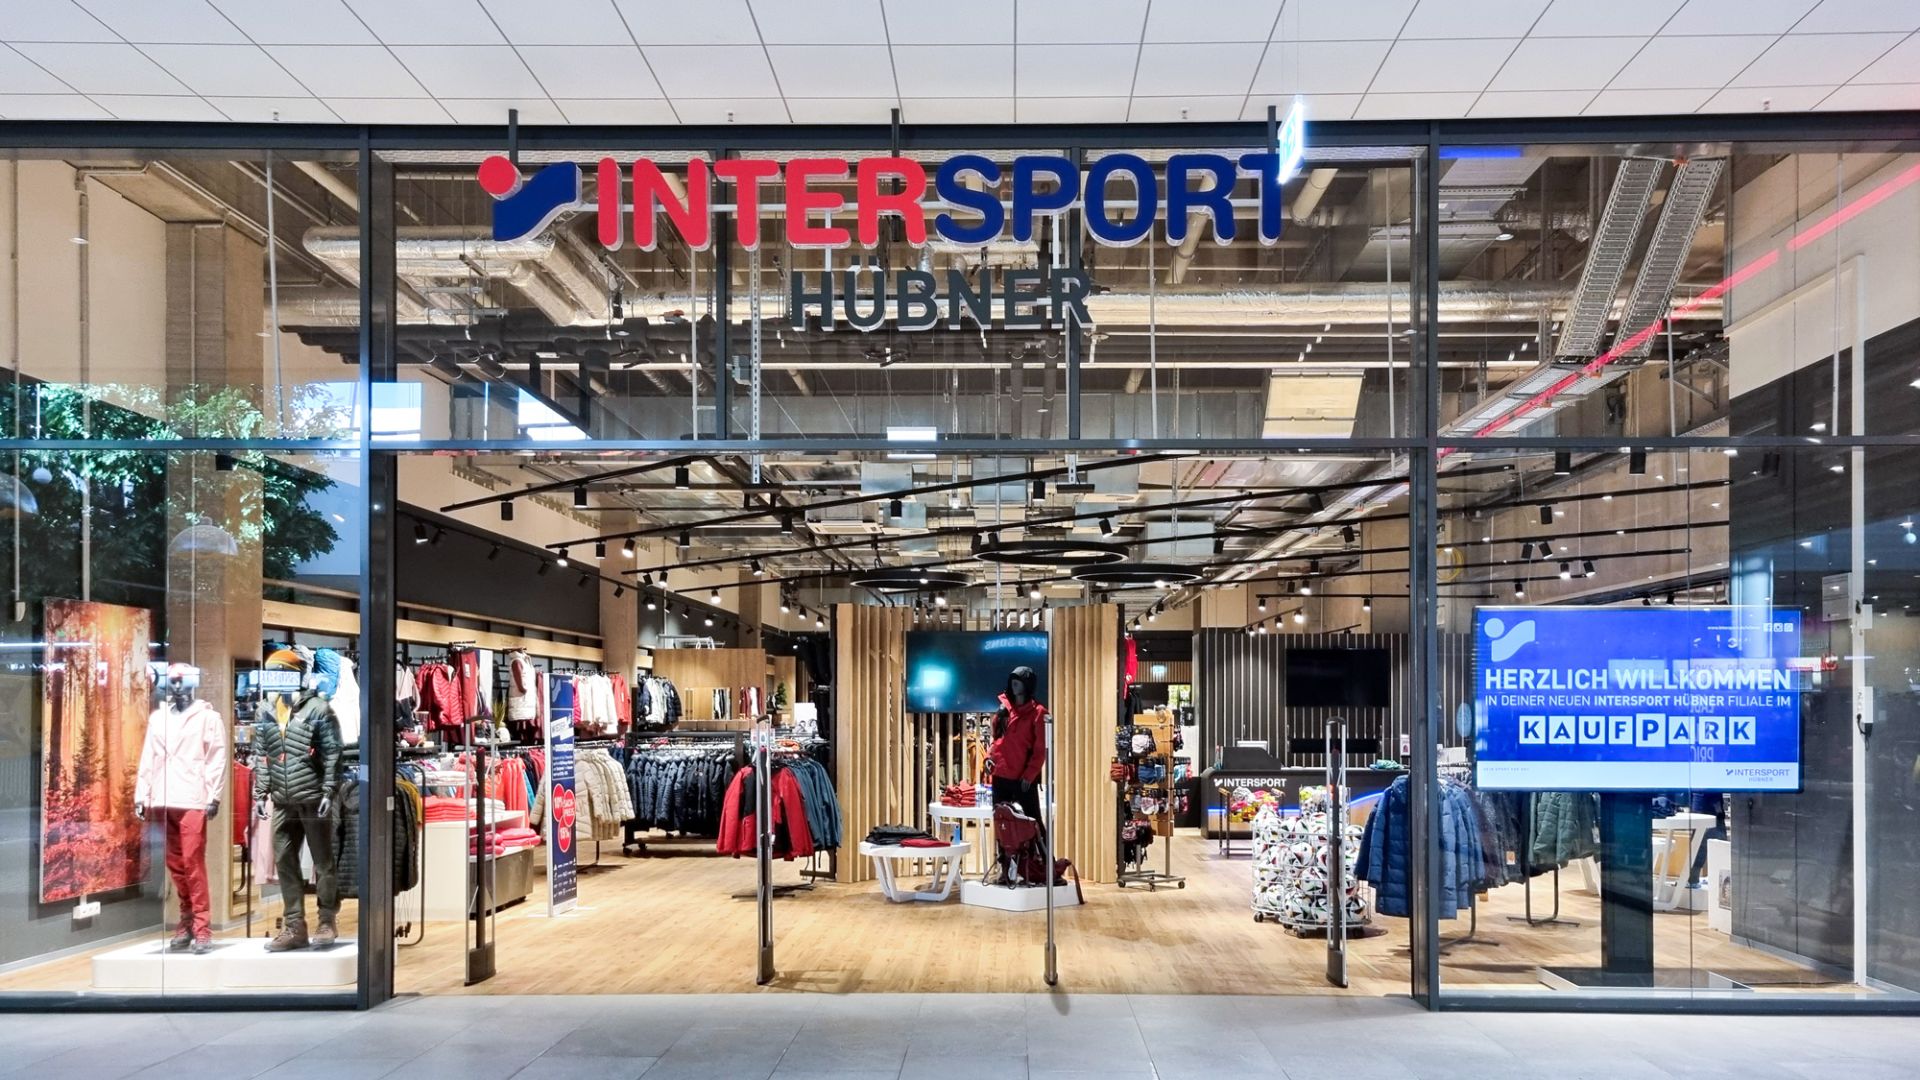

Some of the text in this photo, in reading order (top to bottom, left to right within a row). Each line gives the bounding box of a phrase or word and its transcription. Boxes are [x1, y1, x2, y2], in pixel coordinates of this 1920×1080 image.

[597, 153, 1282, 251] INTERSPORT
[791, 256, 1095, 331] HÜBNER
[1485, 668, 1791, 690] HERZLICH WILLKOMMEN
[1485, 694, 1791, 707] IN DEINER NEUEN INTERSPORT HÜBNER FILIALE IM
[1523, 718, 1751, 742] KAUFPARK
[1224, 778, 1287, 787] INTERSPORT
